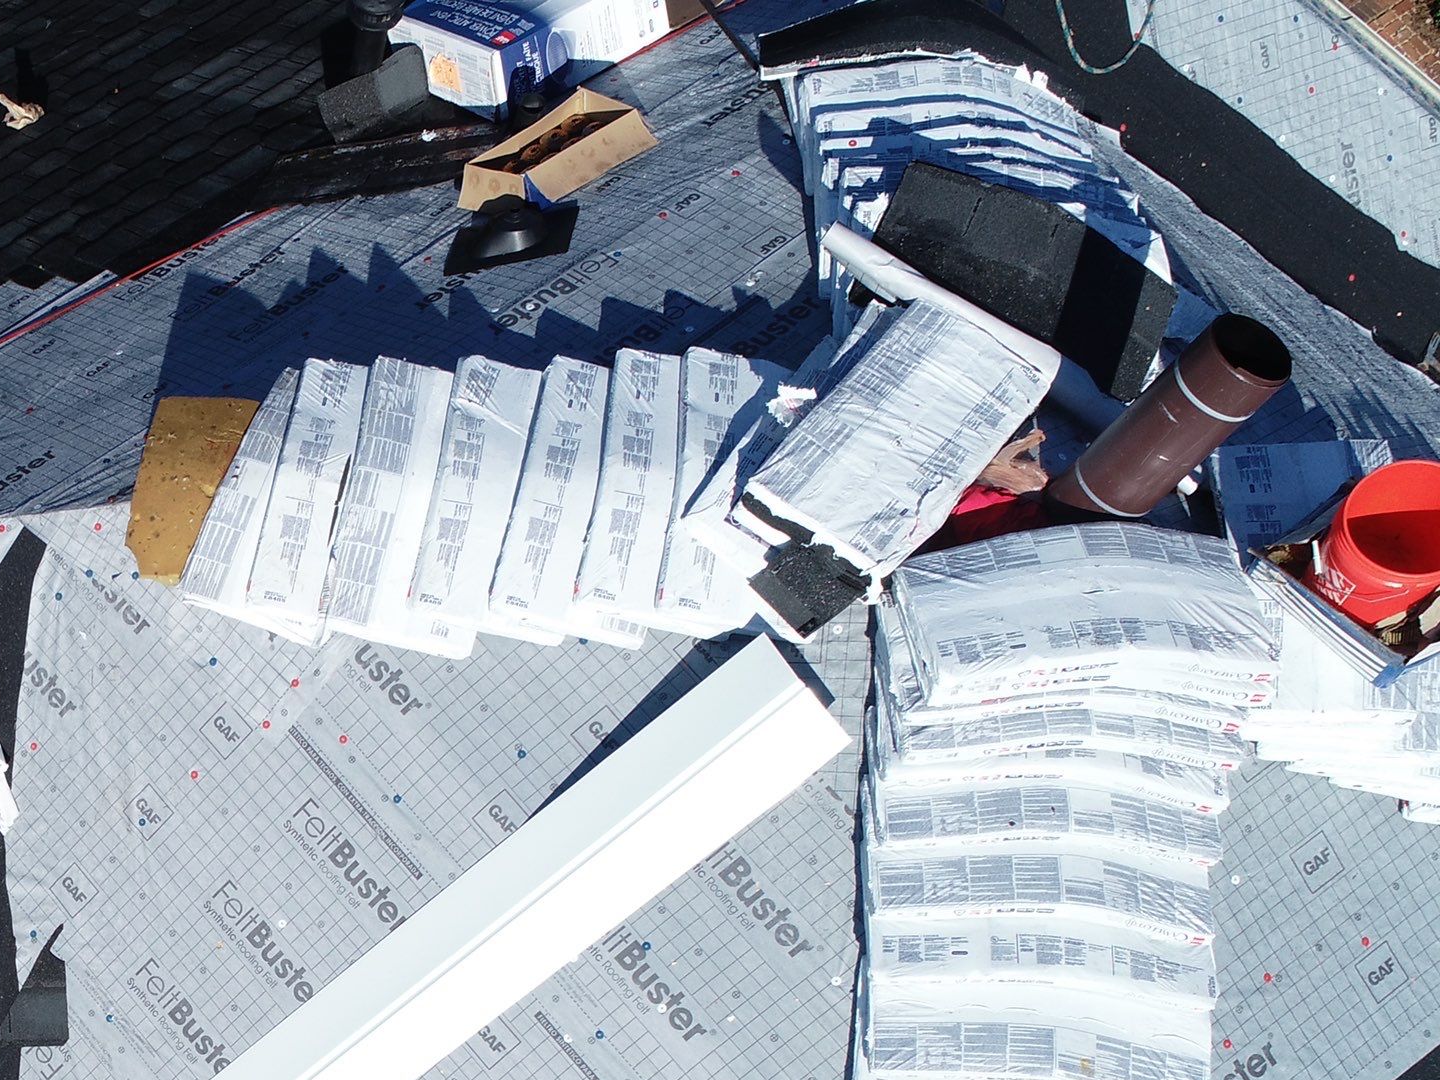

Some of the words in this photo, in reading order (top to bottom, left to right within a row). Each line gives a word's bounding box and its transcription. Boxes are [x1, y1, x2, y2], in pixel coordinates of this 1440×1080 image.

[675, 192, 701, 212] GAF
[759, 235, 788, 257] GAF
[491, 251, 620, 335] FeltBuster
[86, 360, 111, 377] GAF
[212, 716, 240, 745] GAF
[335, 781, 350, 797] CON
[134, 798, 162, 828] GAF
[488, 804, 517, 835] GAF
[280, 817, 321, 862] Synthetic
[314, 858, 348, 896] Roofing
[344, 890, 362, 909] Felt
[1301, 846, 1332, 876] GAF
[61, 876, 88, 905] GAF
[735, 910, 756, 931] Felt
[201, 898, 239, 942] Synthetic
[233, 938, 266, 975] Roofing
[261, 970, 279, 989] Felt
[1367, 958, 1396, 987] GAF
[631, 994, 651, 1015] Felt
[124, 975, 161, 1019] Synthetic
[155, 1015, 186, 1051] Roofing
[182, 1046, 199, 1064] Felt
[476, 1025, 507, 1055] GAF
